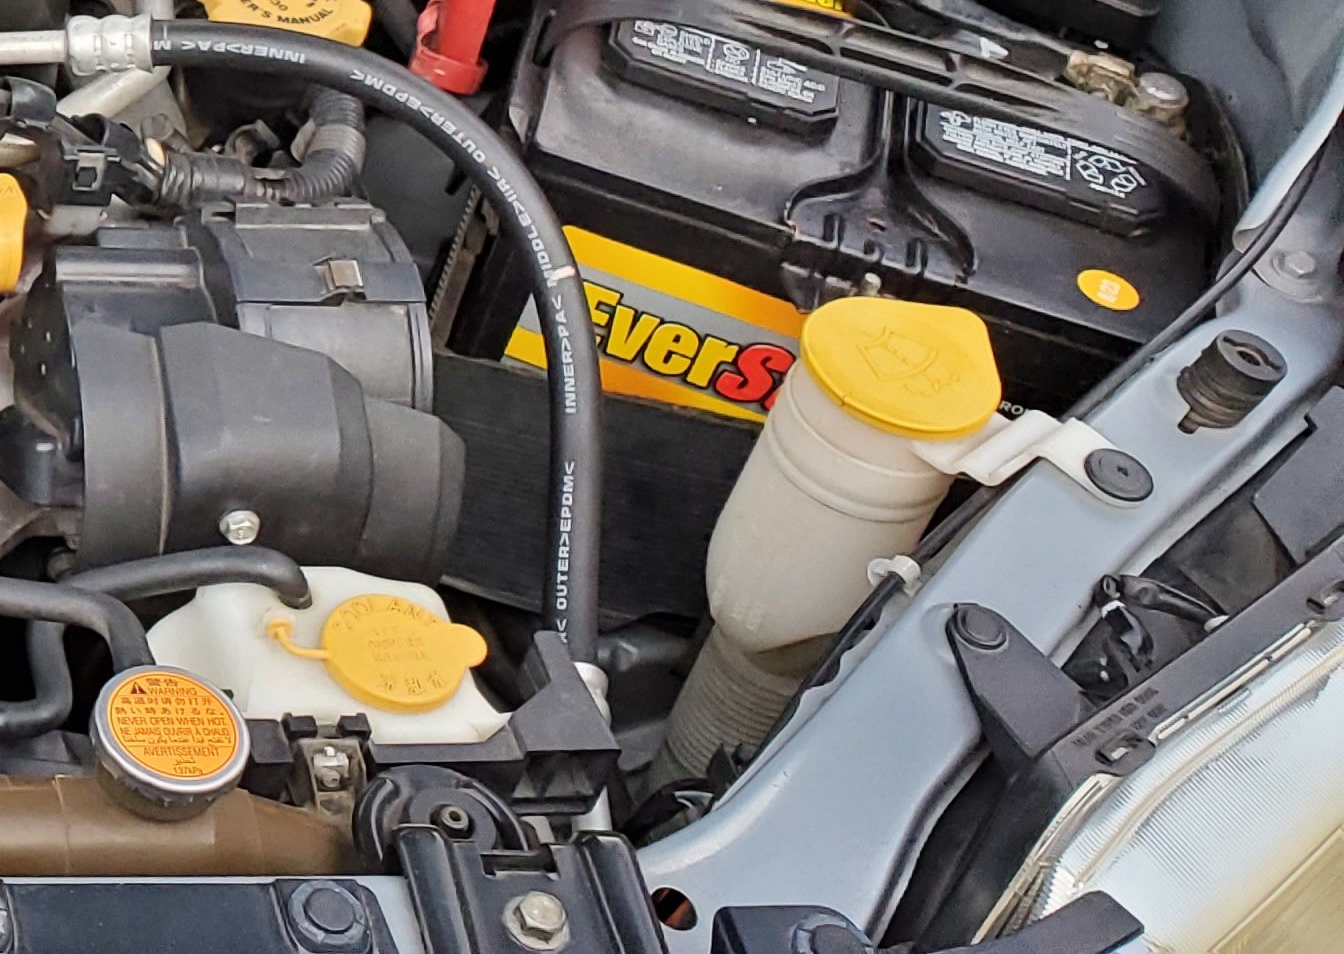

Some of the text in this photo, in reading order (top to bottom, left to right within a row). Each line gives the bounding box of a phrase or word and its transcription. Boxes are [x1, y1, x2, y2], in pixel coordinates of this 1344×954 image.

[277, 7, 334, 24] MANUAL
[582, 279, 796, 411] EverS
[148, 687, 197, 696] WARNING
[117, 717, 148, 726] NEVER
[150, 717, 175, 726] OPEN
[176, 717, 205, 726] WHEN
[144, 747, 219, 757] AVERTISSEMENT
